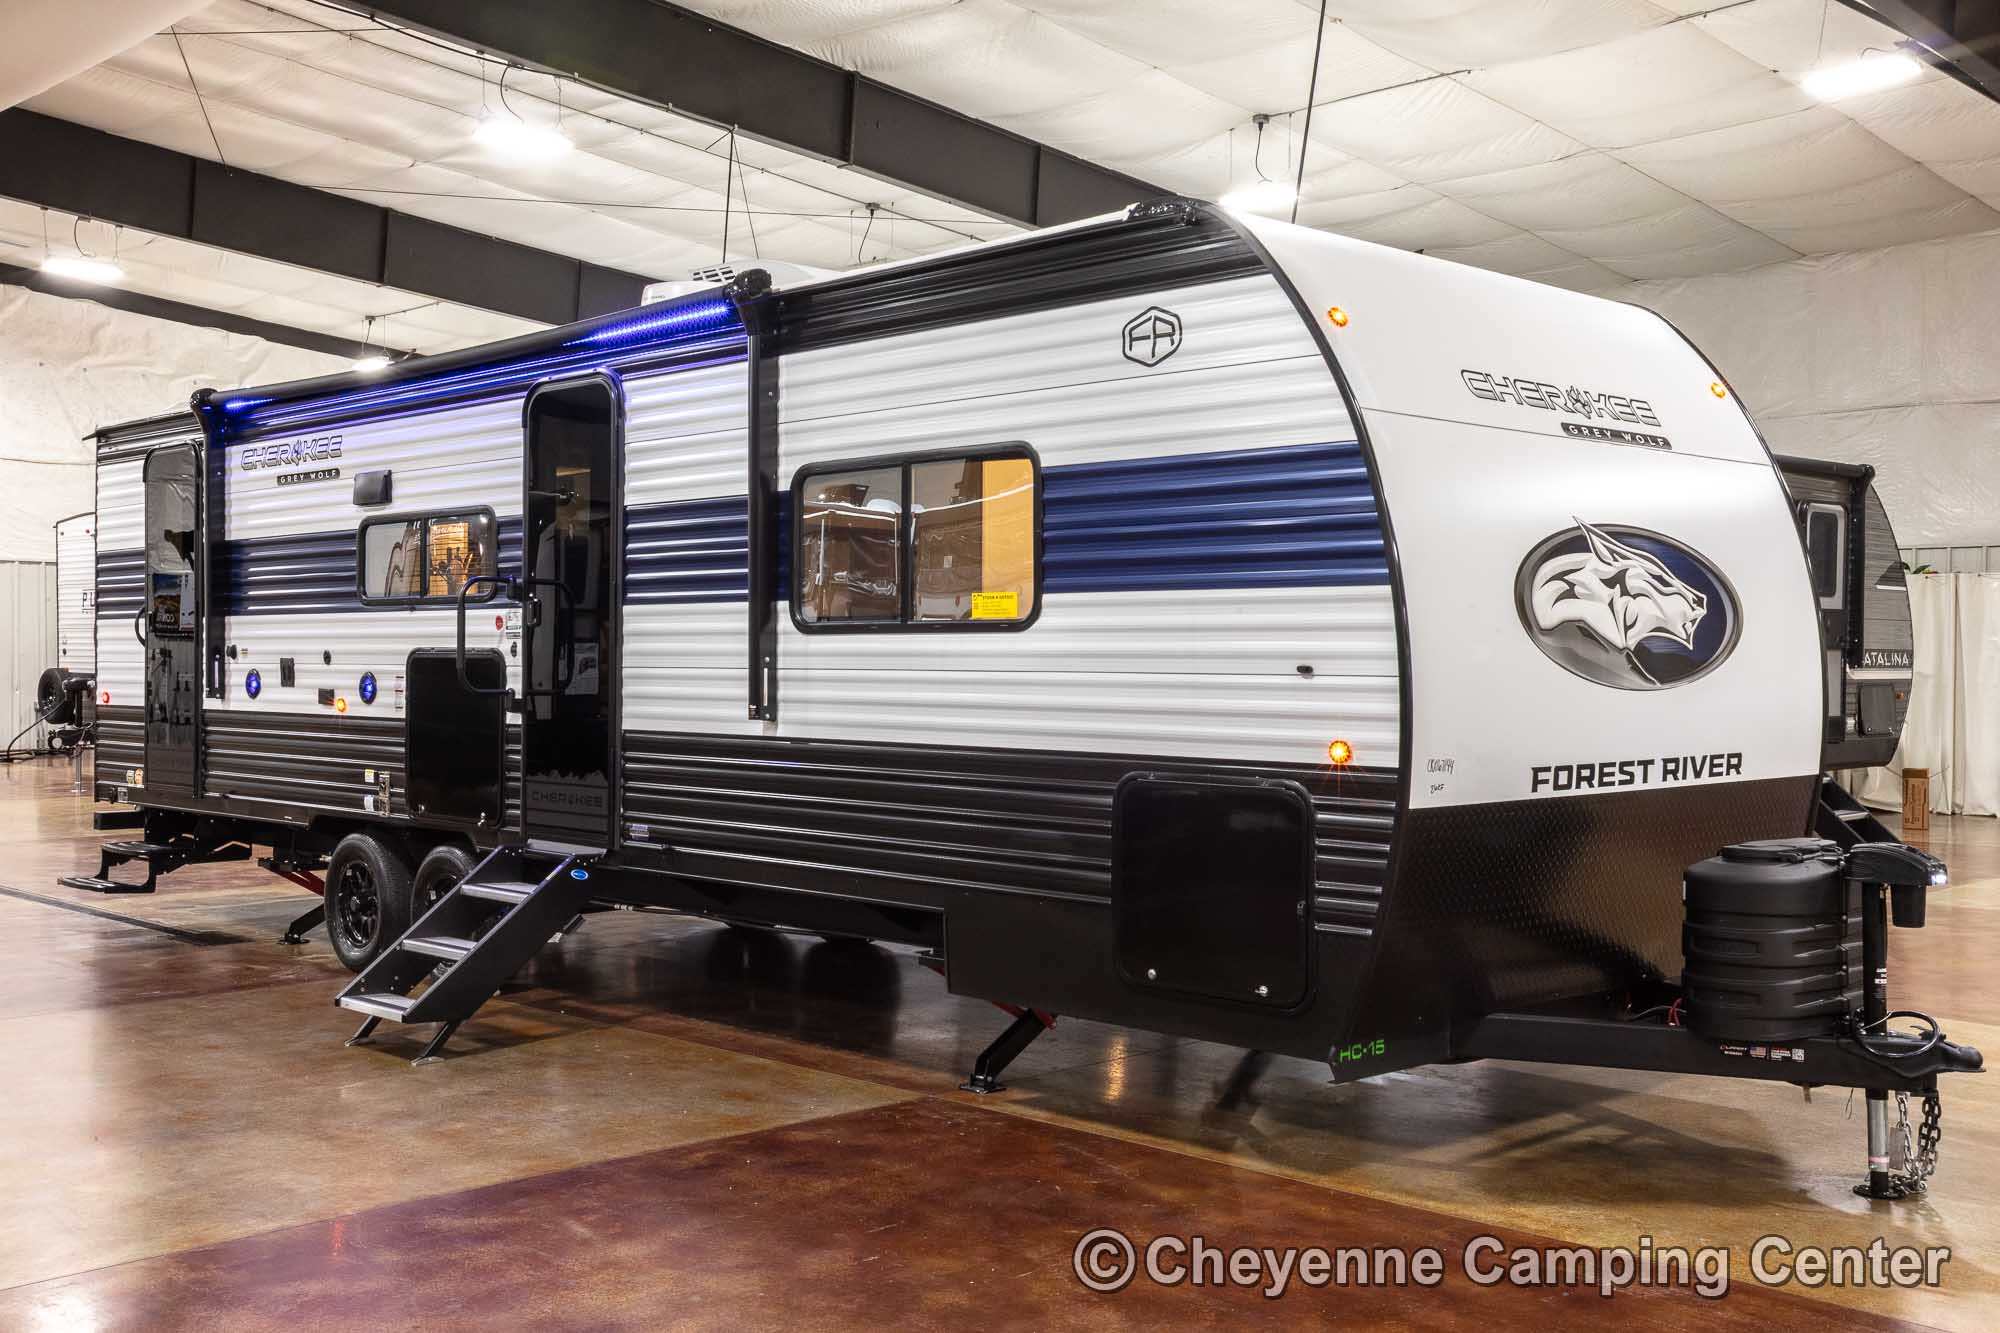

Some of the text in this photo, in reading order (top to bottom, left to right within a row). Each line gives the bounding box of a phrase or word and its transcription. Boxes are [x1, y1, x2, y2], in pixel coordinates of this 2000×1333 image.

[1568, 425, 1666, 447] GREY WOLF
[280, 469, 337, 484] GREY WOLF
[1862, 651, 1909, 666] ATALINA
[1530, 752, 1743, 793] FOREST RIVER
